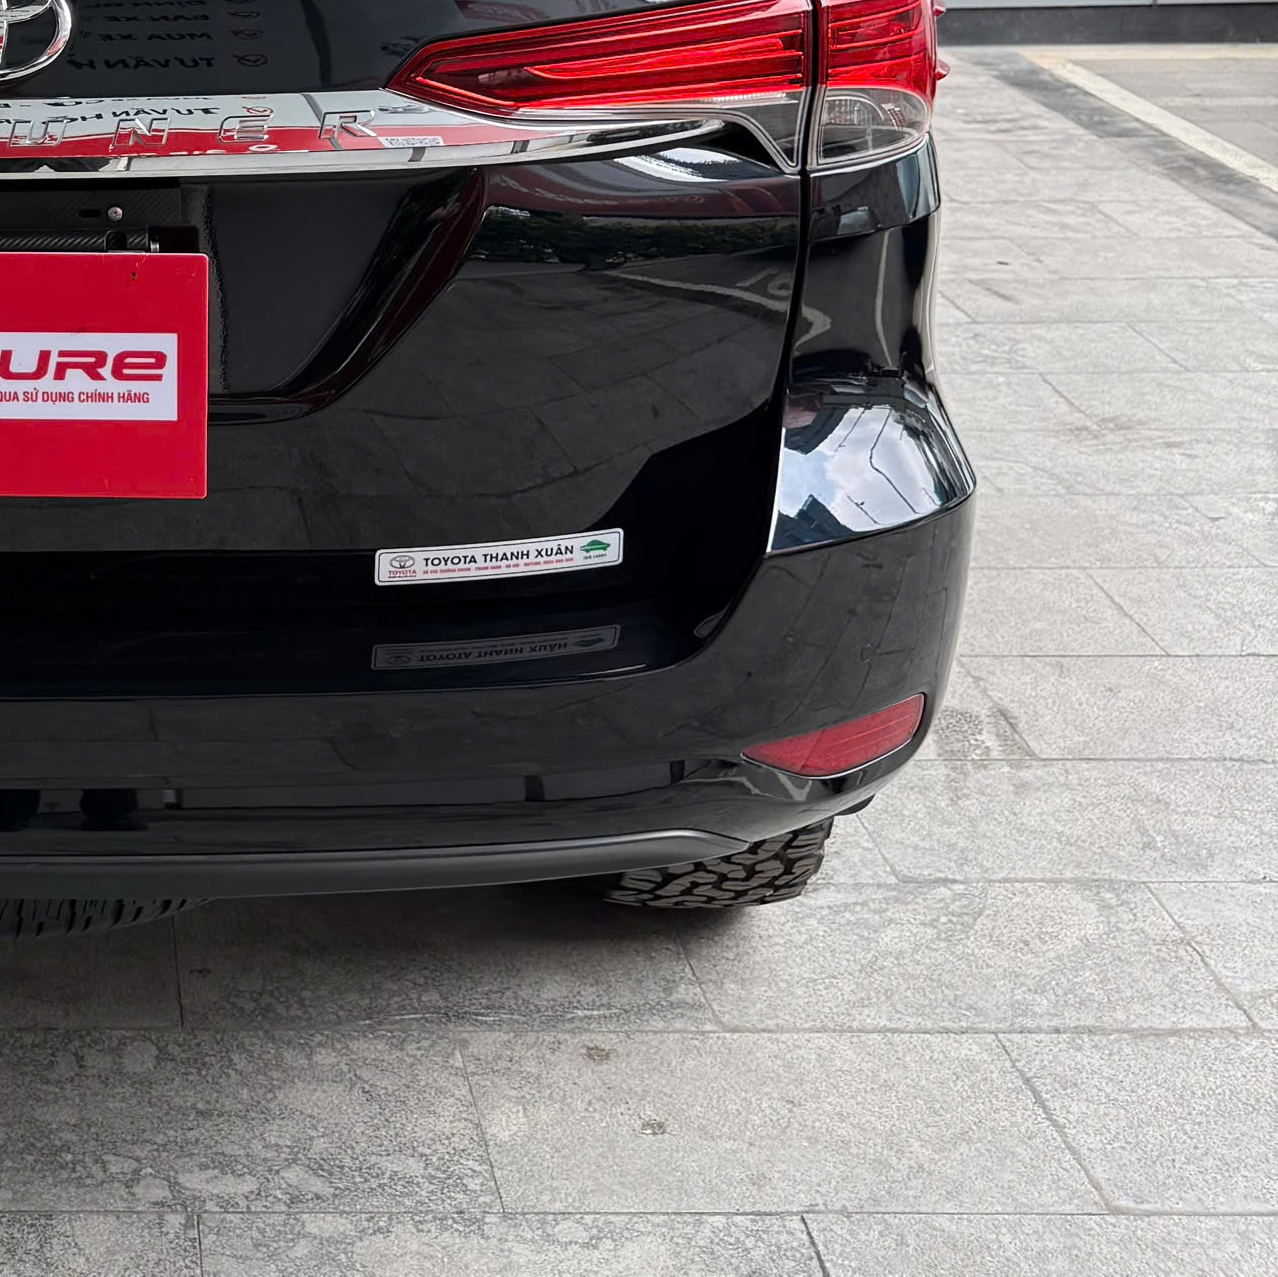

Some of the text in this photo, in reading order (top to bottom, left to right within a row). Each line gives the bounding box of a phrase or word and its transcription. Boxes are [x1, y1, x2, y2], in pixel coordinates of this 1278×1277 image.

[22, 387, 39, 404] SỬ
[41, 391, 75, 406] DỤNG
[78, 389, 114, 404] CHÍNH
[117, 389, 150, 404] HÃNG
[423, 554, 478, 568] TOYOTA
[482, 549, 530, 564] THANH
[534, 543, 574, 559] XUÂN
